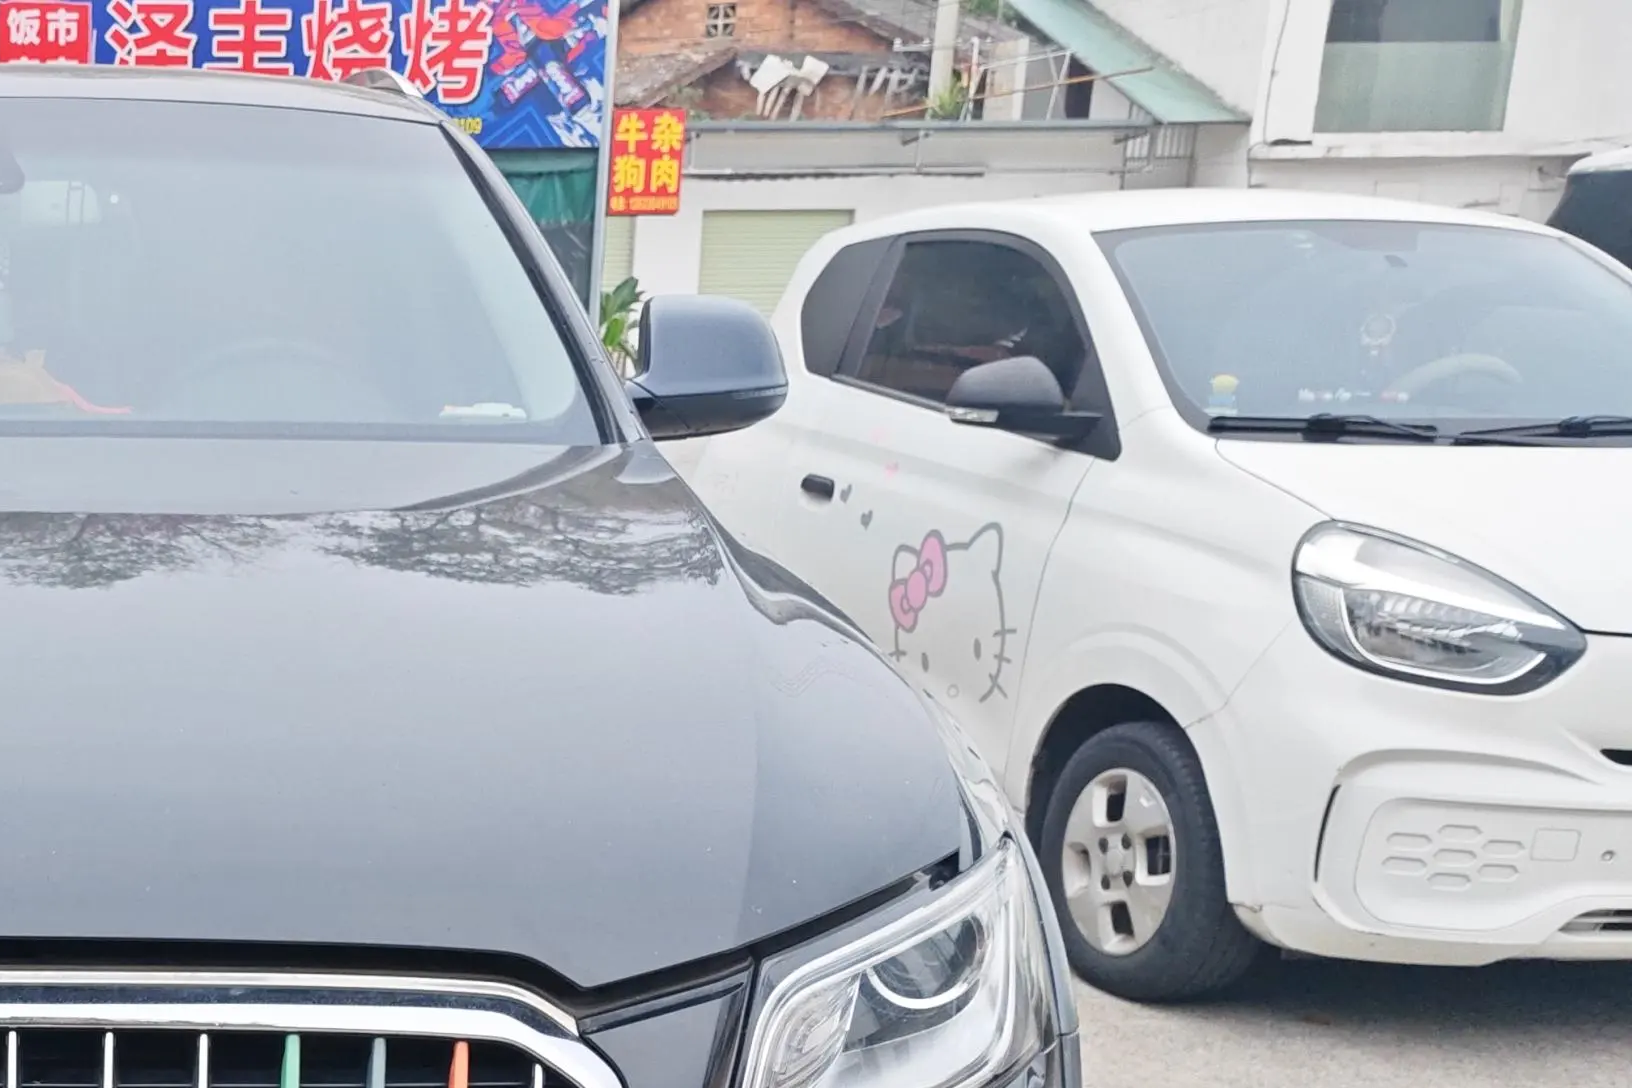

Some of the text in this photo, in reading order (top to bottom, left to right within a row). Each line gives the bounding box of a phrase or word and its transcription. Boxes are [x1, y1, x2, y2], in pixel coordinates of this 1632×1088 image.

[7, 8, 80, 46] 饭市
[105, 0, 493, 104] 泽丰烧烤
[614, 111, 684, 153] 牛杂
[613, 154, 680, 194] 狗肉
